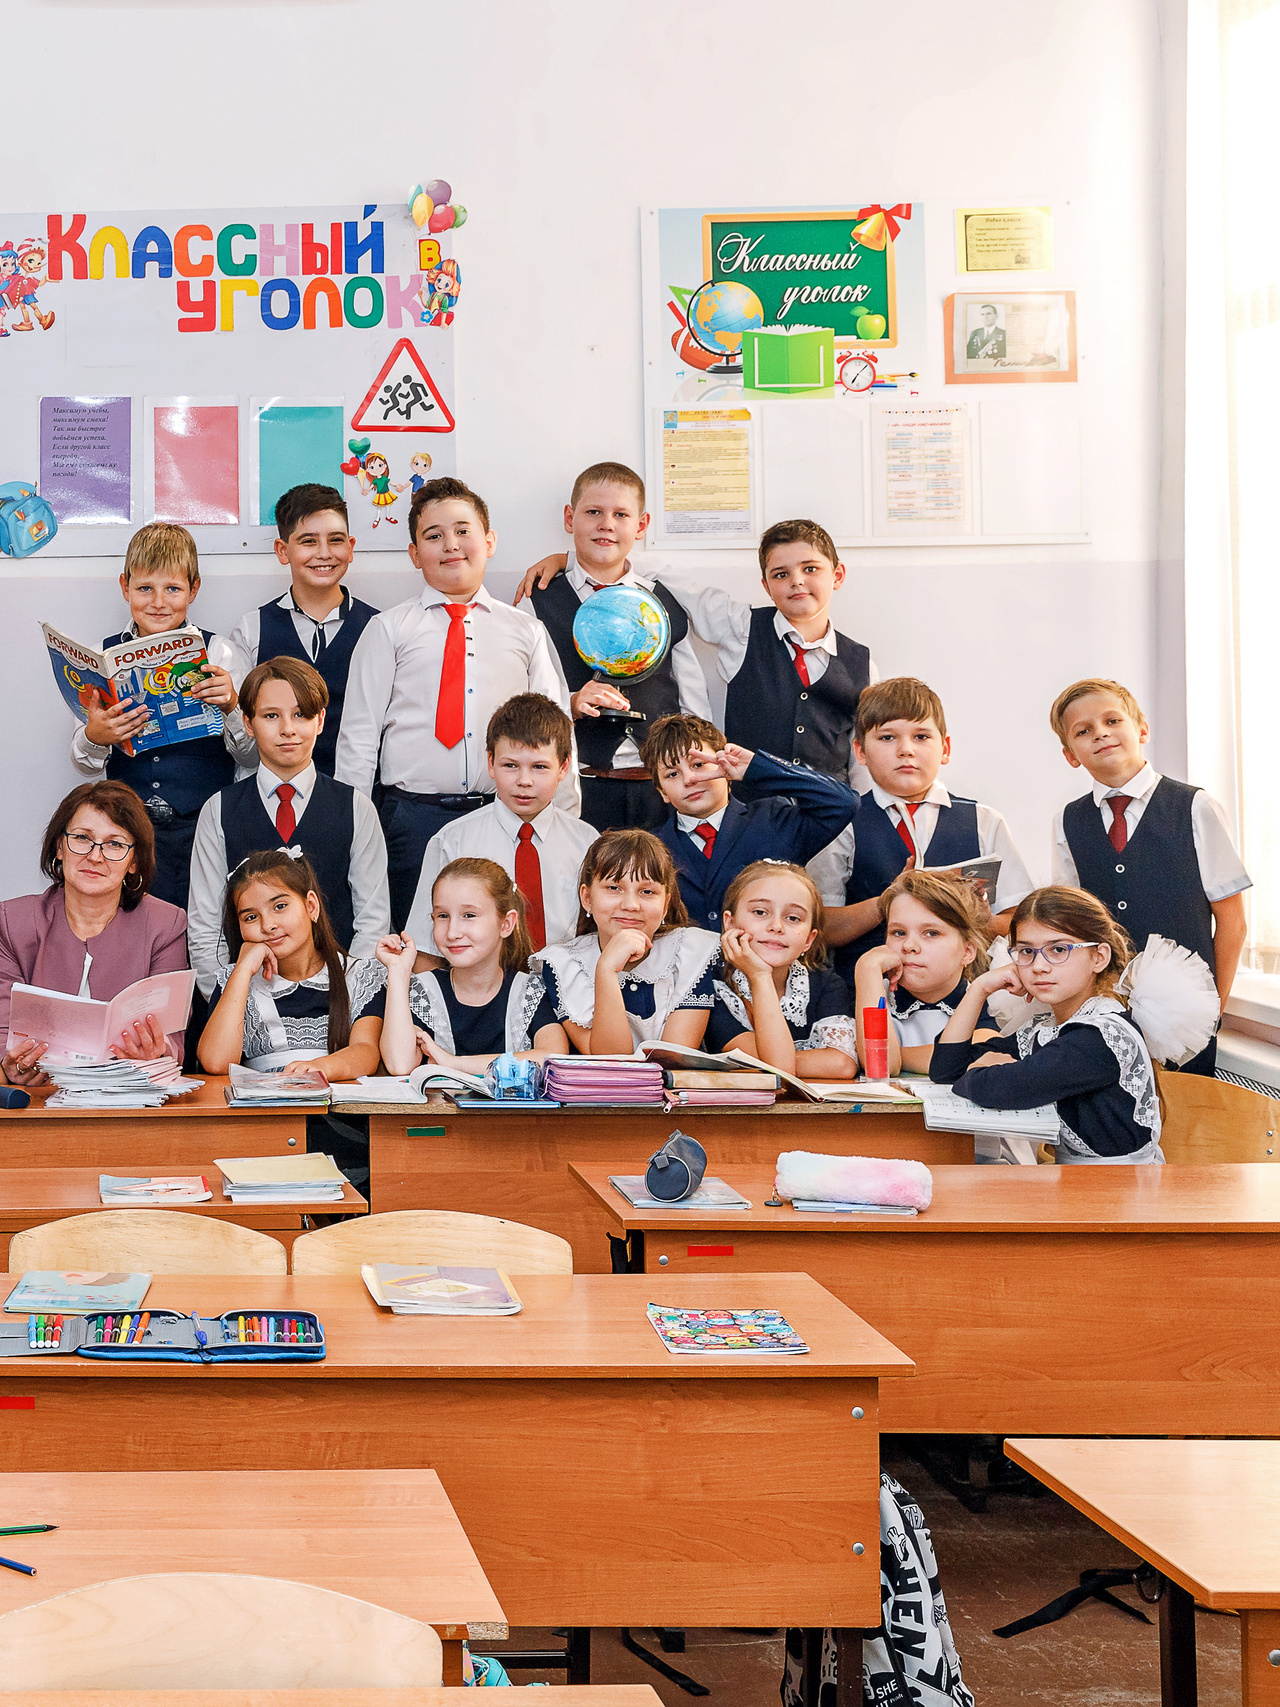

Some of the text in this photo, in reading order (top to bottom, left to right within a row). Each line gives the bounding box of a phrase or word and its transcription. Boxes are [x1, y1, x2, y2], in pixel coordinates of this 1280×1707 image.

[717, 232, 861, 273] Классный
[776, 284, 871, 320] уголок
[114, 638, 194, 667] FORWARD
[157, 673, 165, 682] 4
[876, 1679, 898, 1699] SHE
